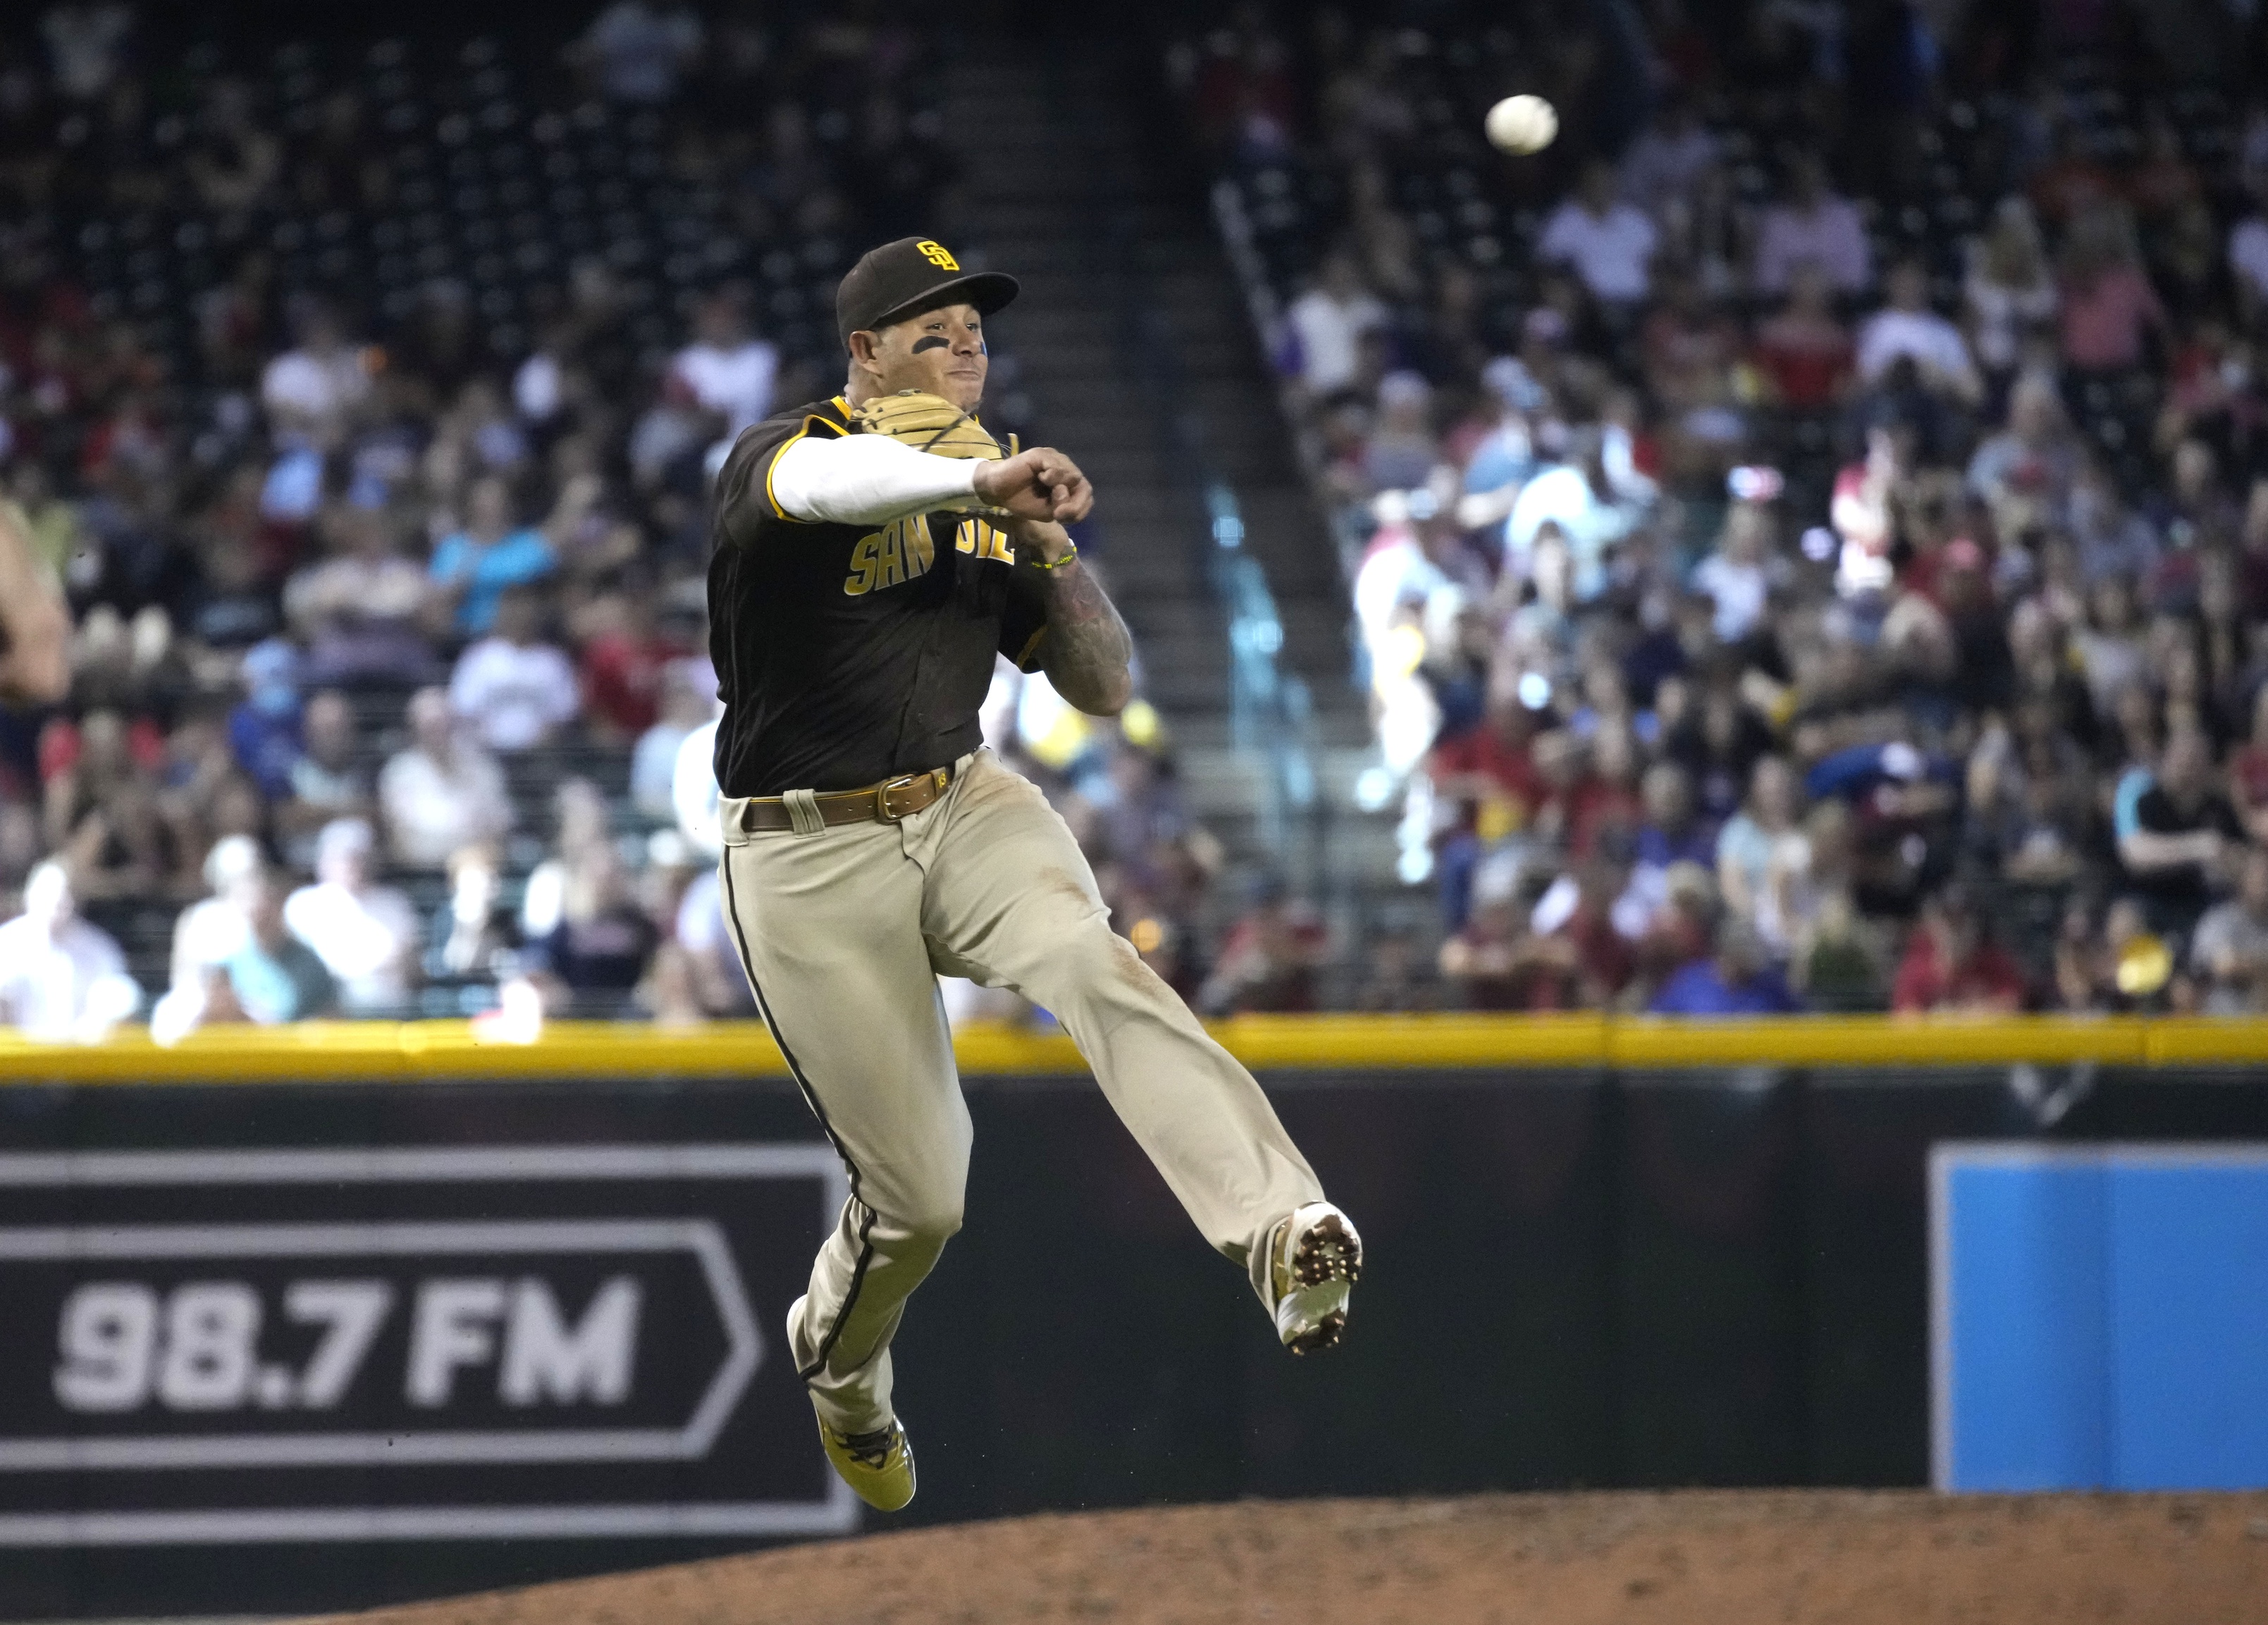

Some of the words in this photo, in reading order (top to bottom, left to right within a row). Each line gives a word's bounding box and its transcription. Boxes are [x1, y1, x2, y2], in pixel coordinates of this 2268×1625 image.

[844, 514, 935, 595] SAN
[54, 1281, 392, 1409] 98.7
[409, 1278, 640, 1407] FM
